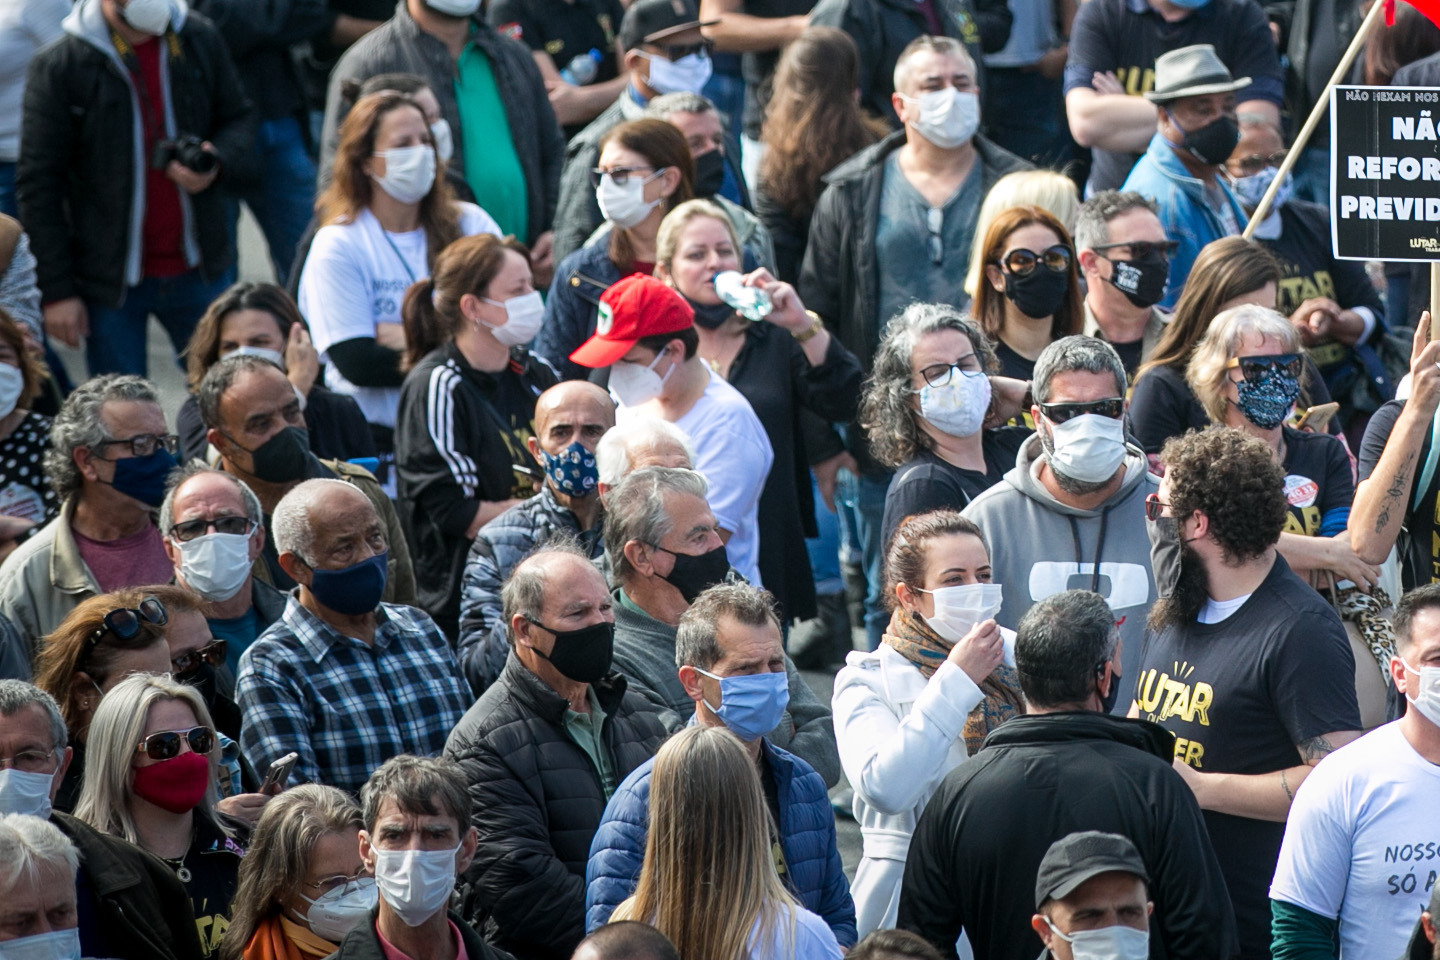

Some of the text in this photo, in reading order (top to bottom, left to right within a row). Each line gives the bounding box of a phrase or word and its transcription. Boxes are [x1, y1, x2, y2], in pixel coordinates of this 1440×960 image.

[1346, 90, 1369, 101] NÃO
[1415, 92, 1439, 103] NOS
[1410, 238, 1437, 248] LUTAR
[1388, 866, 1417, 895] SÓ
